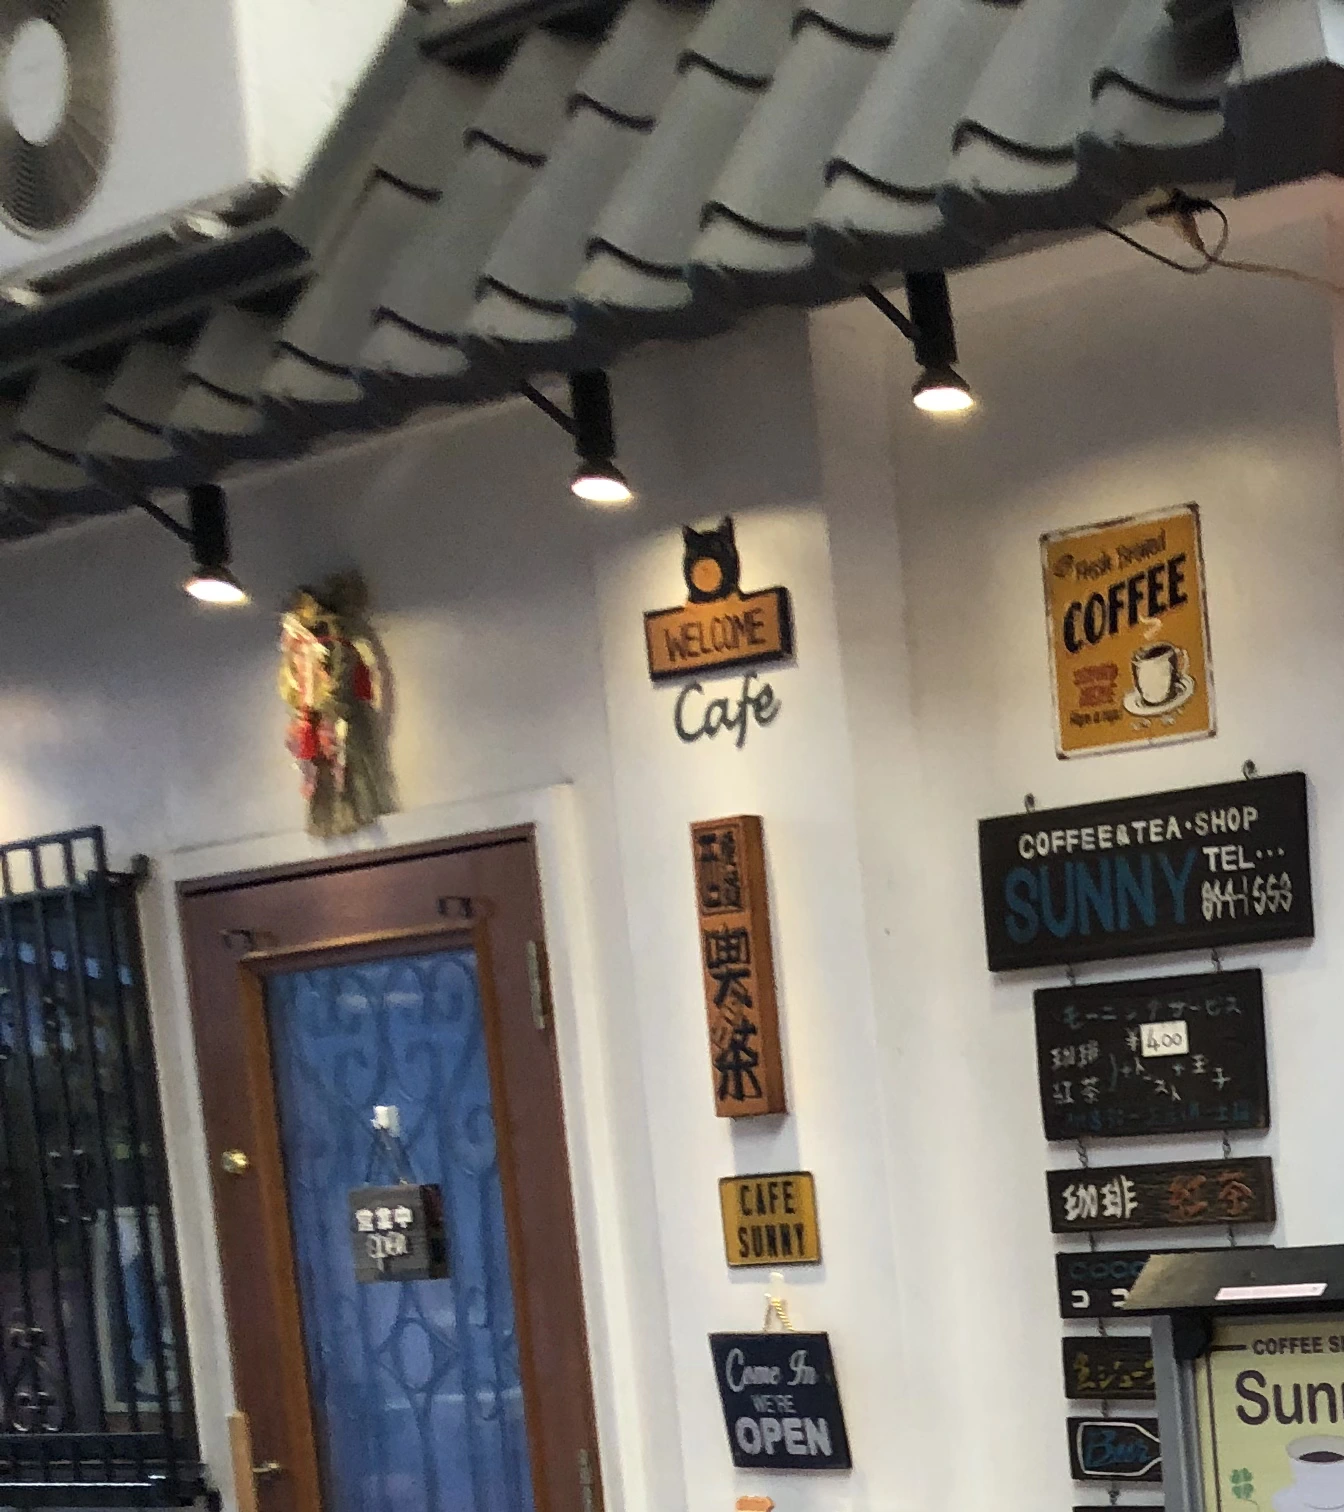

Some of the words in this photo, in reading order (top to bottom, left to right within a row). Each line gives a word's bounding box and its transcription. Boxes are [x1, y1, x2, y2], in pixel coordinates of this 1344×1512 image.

[1063, 553, 1188, 653] COFFEE
[664, 607, 766, 661] WELCOME
[675, 673, 780, 748] Cafe
[1005, 849, 1198, 943] SUNNY
[739, 1181, 796, 1216] CAFE
[1062, 1175, 1138, 1221] 珈琲
[738, 1222, 805, 1258] SUNNY
[1253, 1335, 1323, 1356] COFFEE
[726, 1347, 781, 1393] Come
[735, 1417, 833, 1456] OPEN
